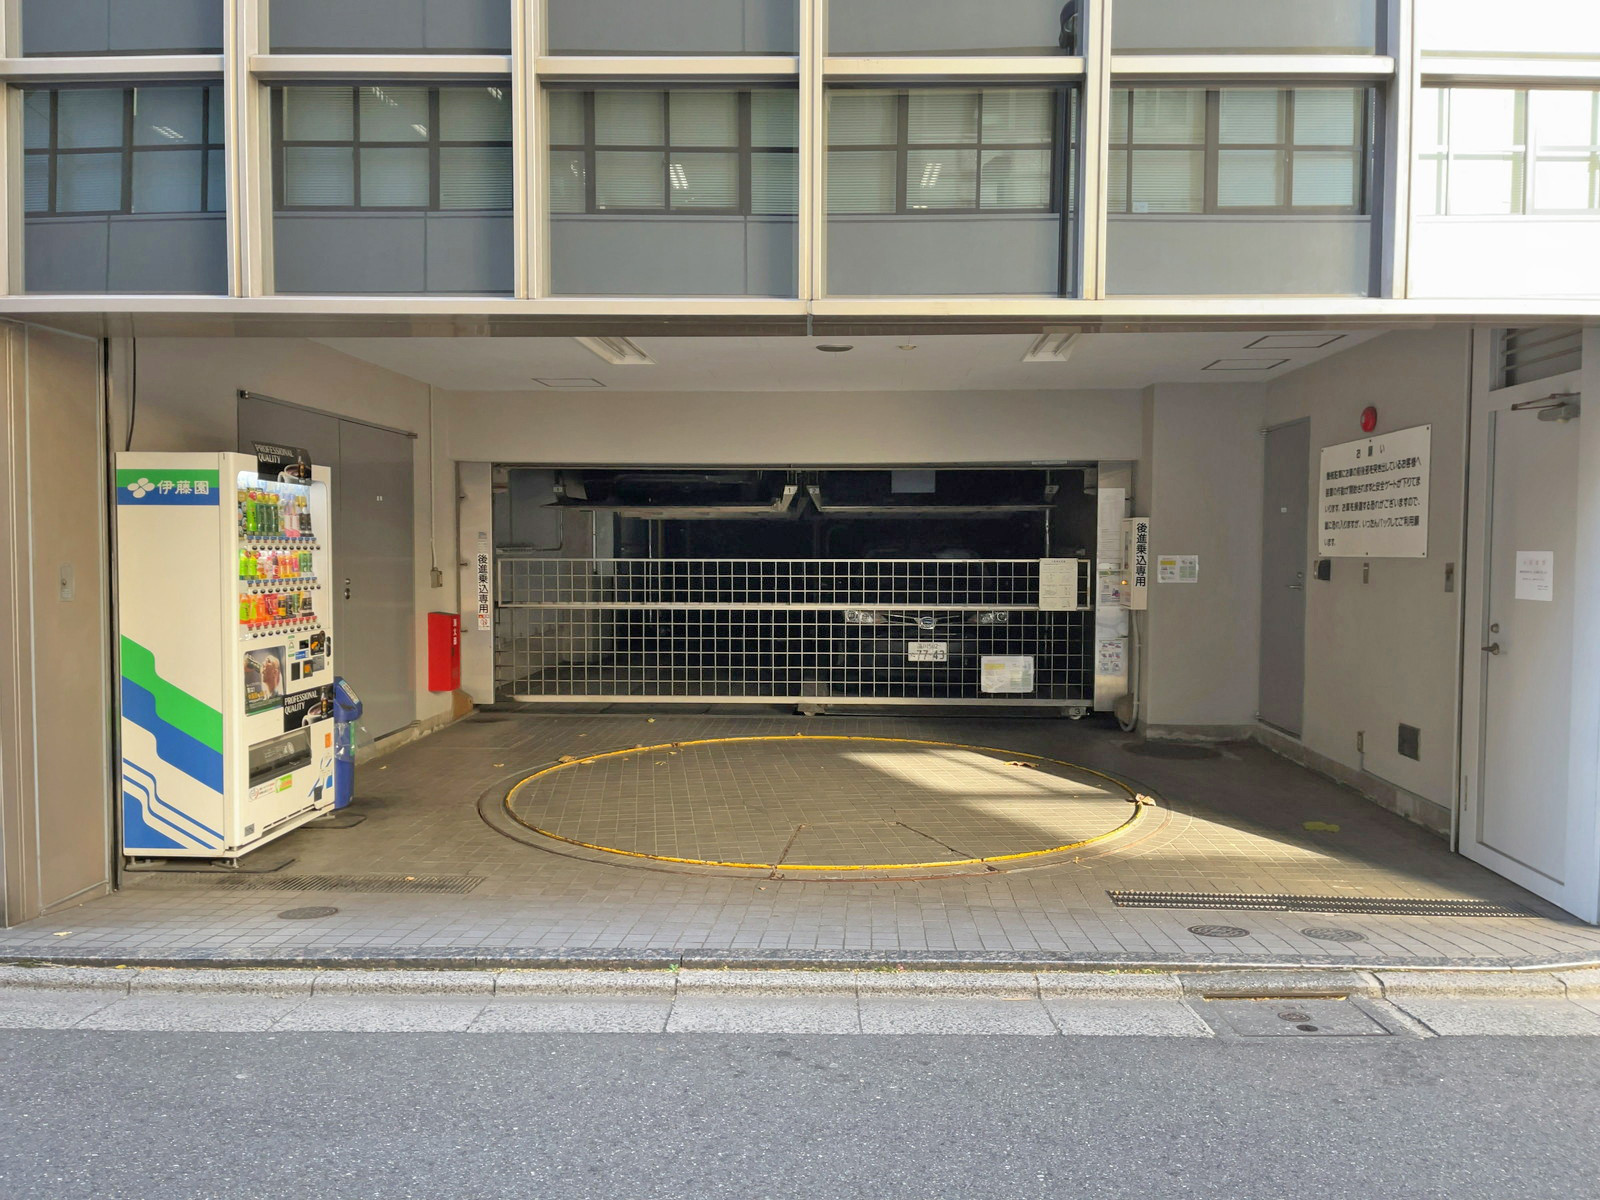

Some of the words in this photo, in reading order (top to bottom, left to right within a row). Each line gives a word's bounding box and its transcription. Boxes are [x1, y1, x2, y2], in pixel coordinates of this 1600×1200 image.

[254, 444, 294, 457] PROFESSIONAL
[1355, 444, 1386, 459] お願い
[258, 453, 281, 464] QUALITY
[156, 479, 210, 496] 伊藤園
[1135, 522, 1148, 588] 後進乗込専用
[477, 553, 489, 614] 後進乗込専用
[916, 650, 945, 660] 77-43
[284, 690, 318, 706] PROFESSIONAL
[284, 702, 306, 716] QUALITY
